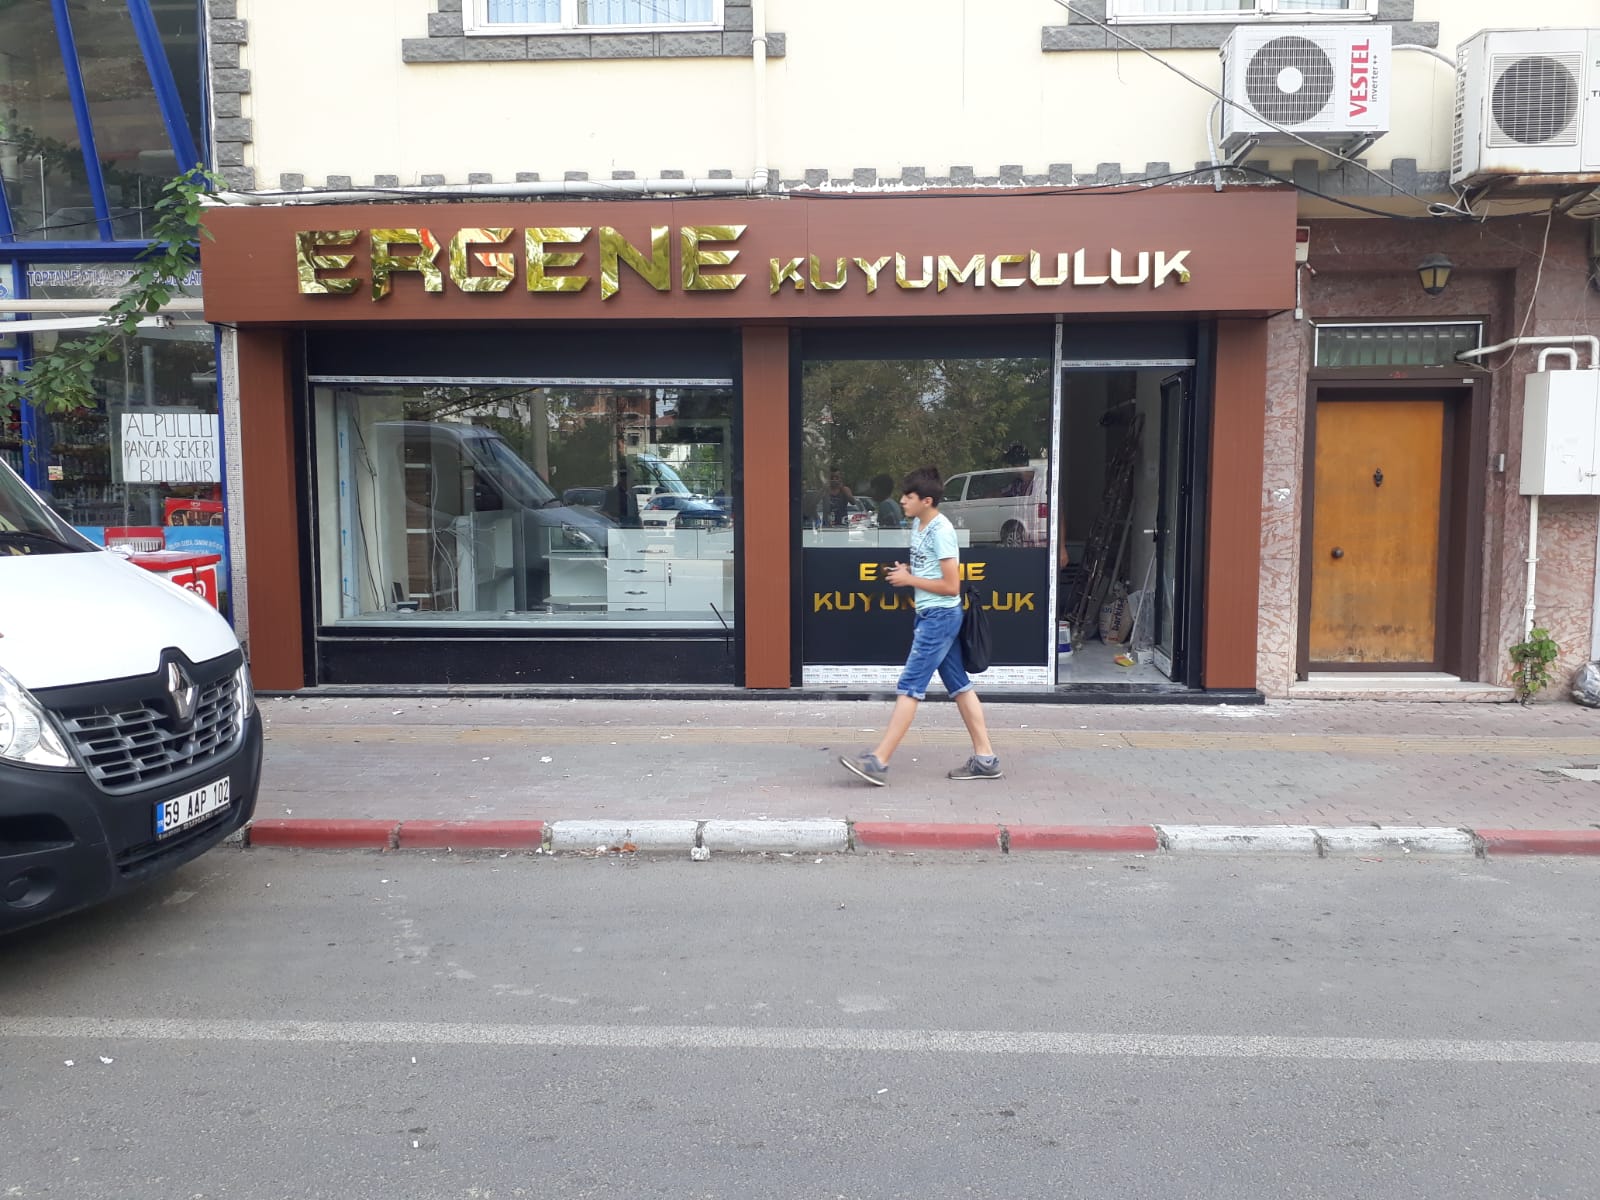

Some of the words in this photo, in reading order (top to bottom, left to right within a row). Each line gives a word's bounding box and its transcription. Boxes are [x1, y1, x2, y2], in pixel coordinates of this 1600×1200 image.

[1349, 38, 1370, 118] VESTEL
[295, 224, 749, 302] ERGENE
[769, 247, 1192, 295] KUYUMCULUK
[126, 413, 214, 438] ALPULLU
[140, 460, 214, 482] BULUNUR
[165, 801, 179, 827] 59
[188, 790, 206, 819] AAP
[214, 780, 229, 806] 102
